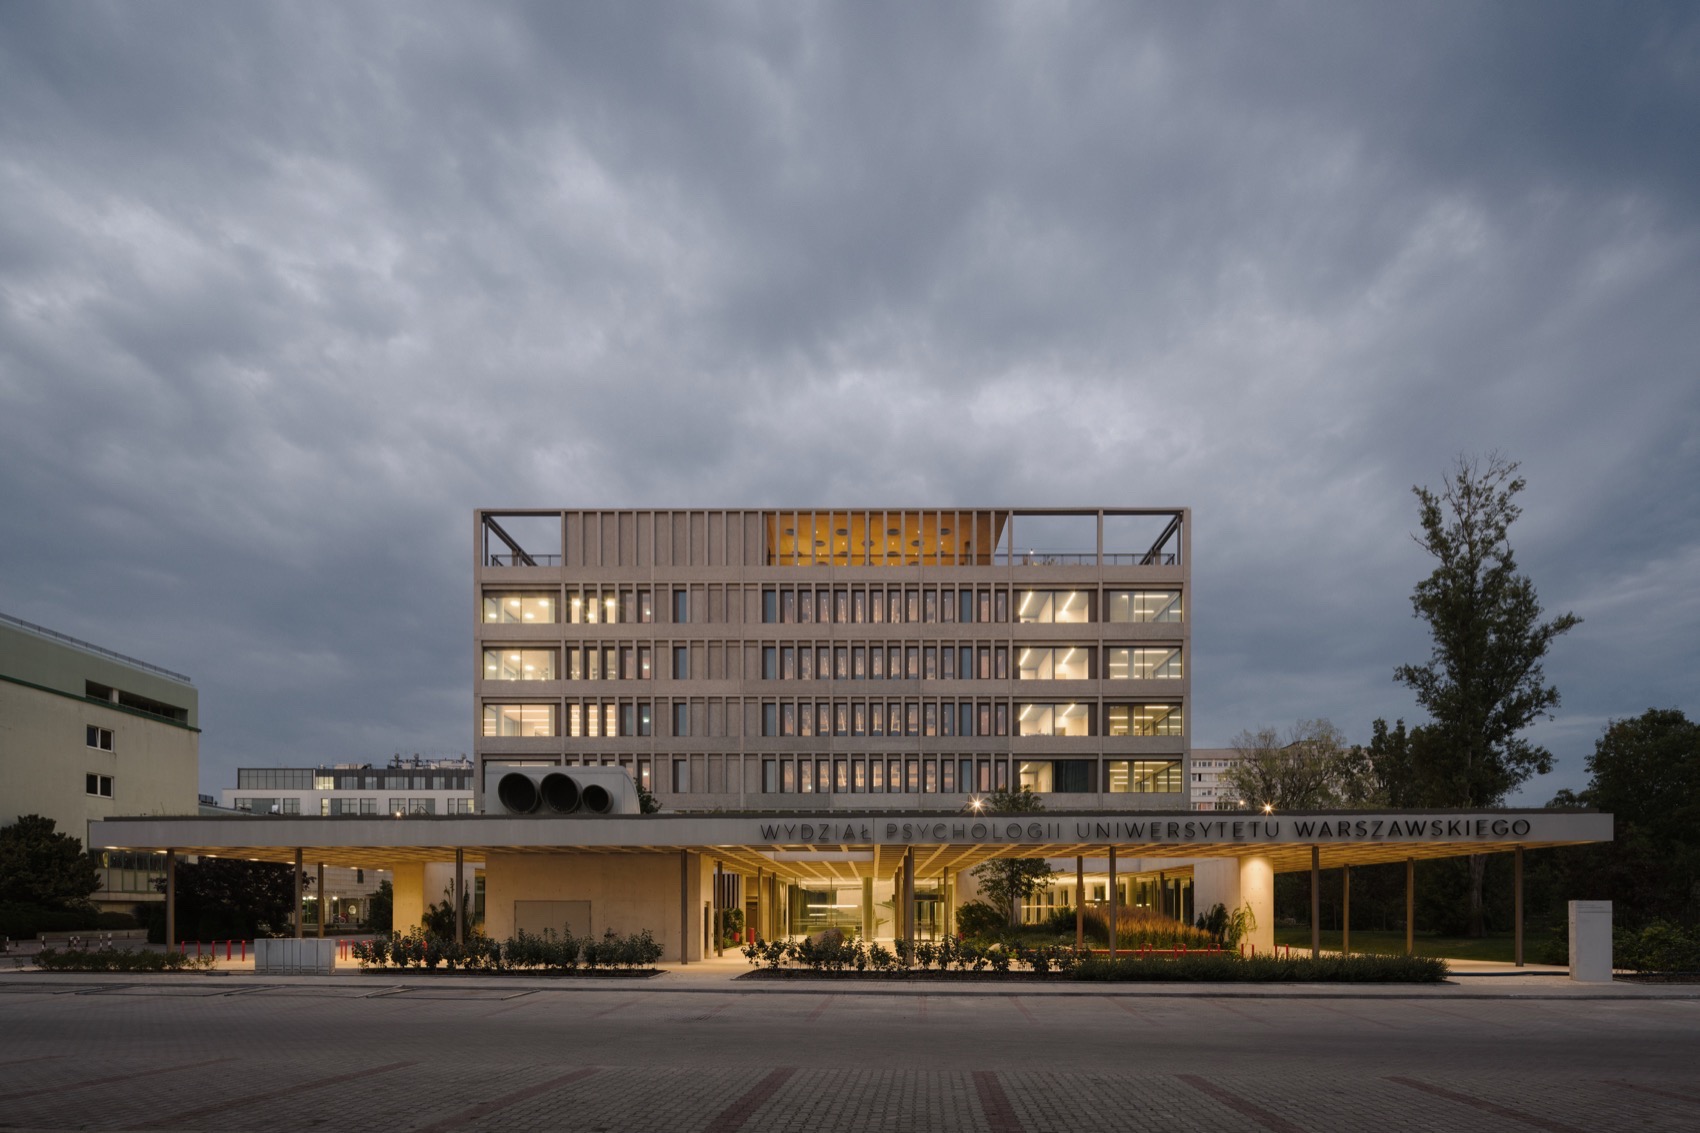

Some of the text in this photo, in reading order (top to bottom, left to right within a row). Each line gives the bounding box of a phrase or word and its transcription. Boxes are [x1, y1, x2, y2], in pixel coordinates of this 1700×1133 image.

[761, 819, 1532, 841] WYDZIAŁ PSYCHOLOGII UNIWERSYTETU WARSZAWSKIEGO
